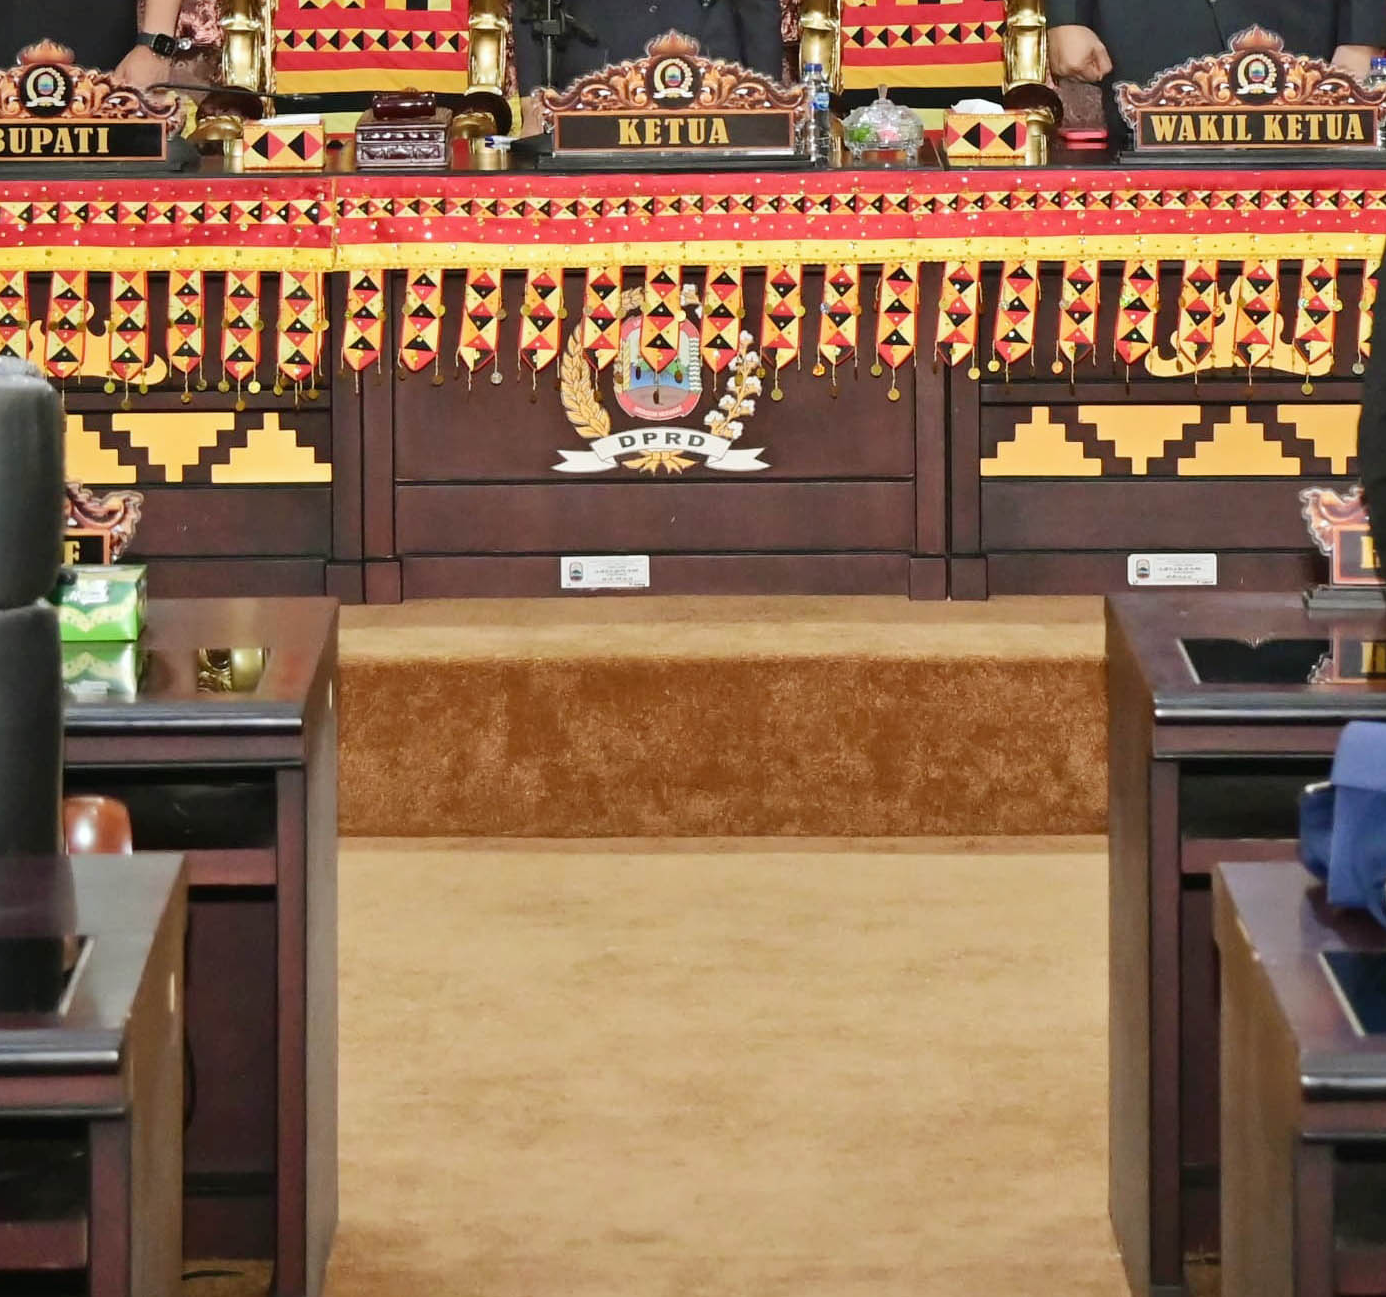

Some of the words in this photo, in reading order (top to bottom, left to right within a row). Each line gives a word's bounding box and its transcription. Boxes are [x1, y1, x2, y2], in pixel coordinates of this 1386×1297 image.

[618, 117, 730, 145] KETUA
[1150, 114, 1252, 142] WAKIL
[1262, 113, 1365, 141] KETUA
[618, 432, 706, 448] DPRD
